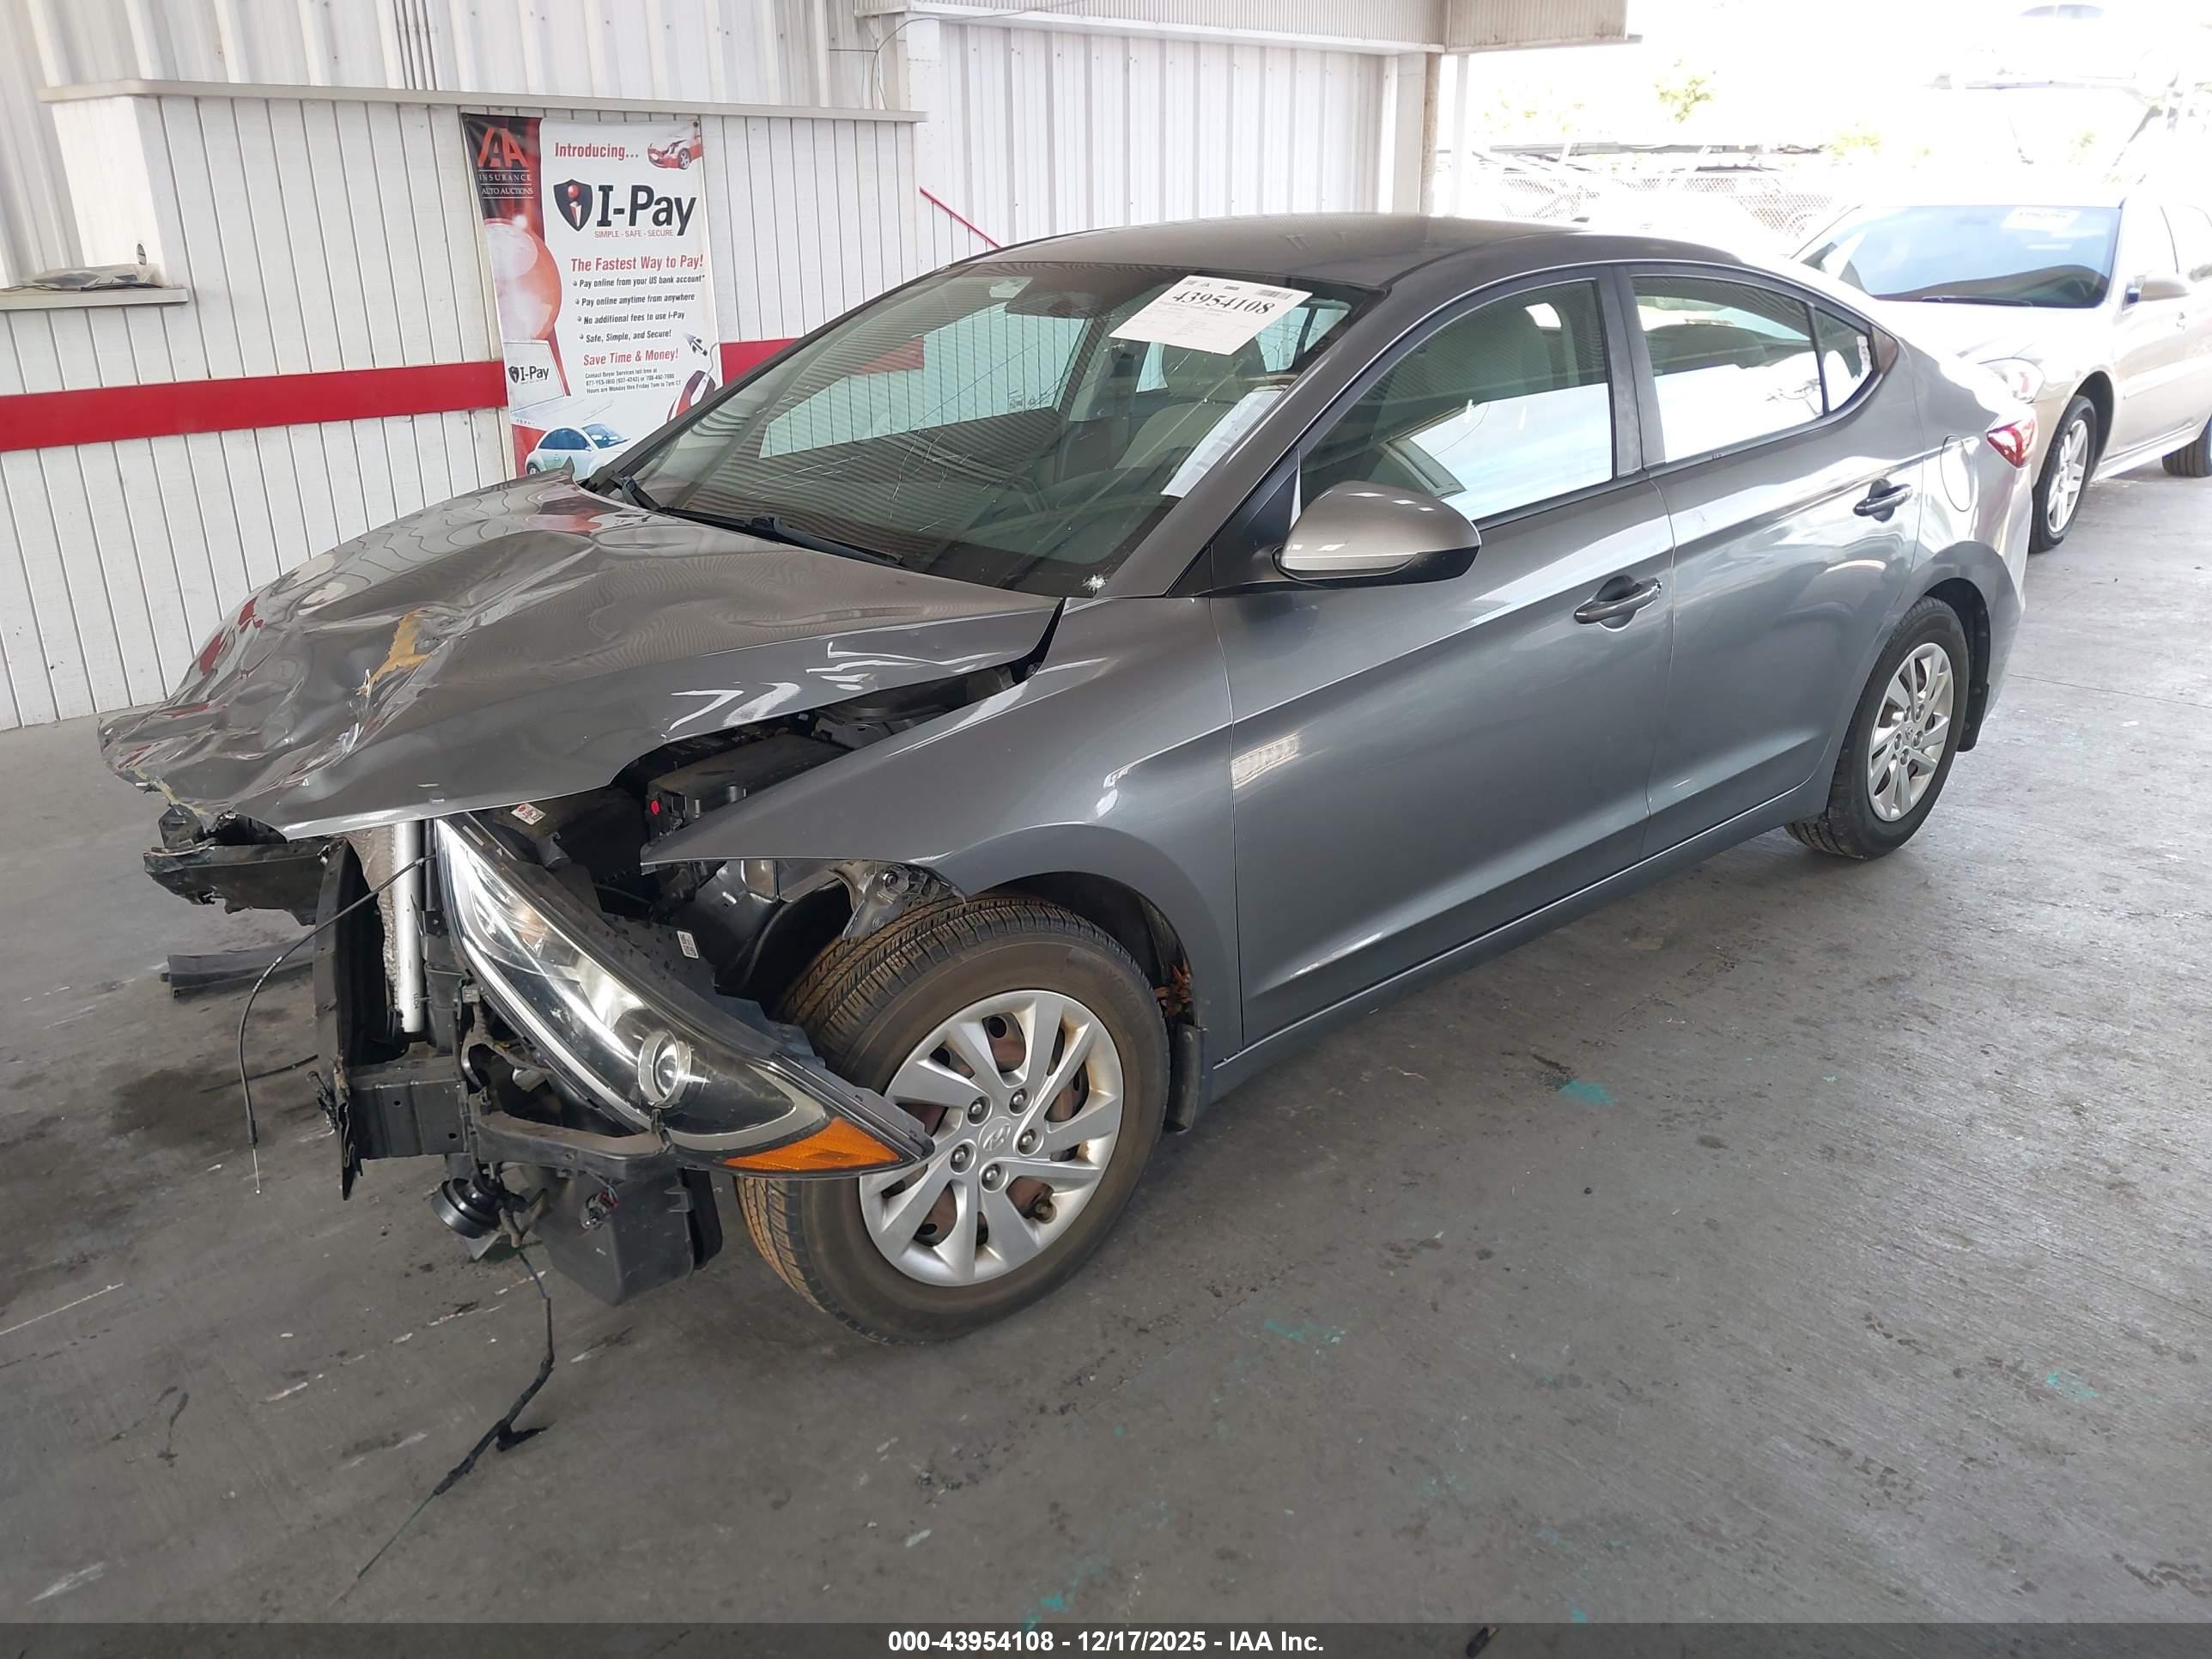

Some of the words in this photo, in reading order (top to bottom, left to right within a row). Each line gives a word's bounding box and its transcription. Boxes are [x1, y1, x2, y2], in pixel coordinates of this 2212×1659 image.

[555, 143, 639, 161] Introducing...
[597, 185, 696, 236] I-Pay
[571, 258, 592, 272] The
[595, 257, 636, 271] Fastest
[641, 256, 663, 271] Way
[666, 256, 676, 268] to
[680, 254, 703, 270] Pay!
[580, 279, 592, 289] Pay
[594, 279, 615, 288] online
[617, 277, 631, 286] from
[633, 278, 647, 287] your
[659, 276, 674, 284] bank
[581, 298, 594, 307] Pay
[596, 297, 617, 306] online
[619, 295, 645, 306] anytime
[647, 294, 662, 302] from
[664, 293, 695, 302] anywhere
[1172, 290, 1275, 314] 43954108
[584, 316, 592, 325] No
[595, 314, 629, 324] additional
[630, 313, 645, 321] fees
[668, 311, 685, 320] I-Pay
[586, 334, 604, 343] Safe,
[606, 331, 631, 342] Simple,
[633, 331, 645, 340] and
[647, 329, 672, 339] Secure!
[584, 354, 606, 366] Save
[610, 352, 632, 364] Time
[635, 350, 642, 362] &
[645, 348, 678, 362] Money!
[520, 366, 550, 380] I-Pay
